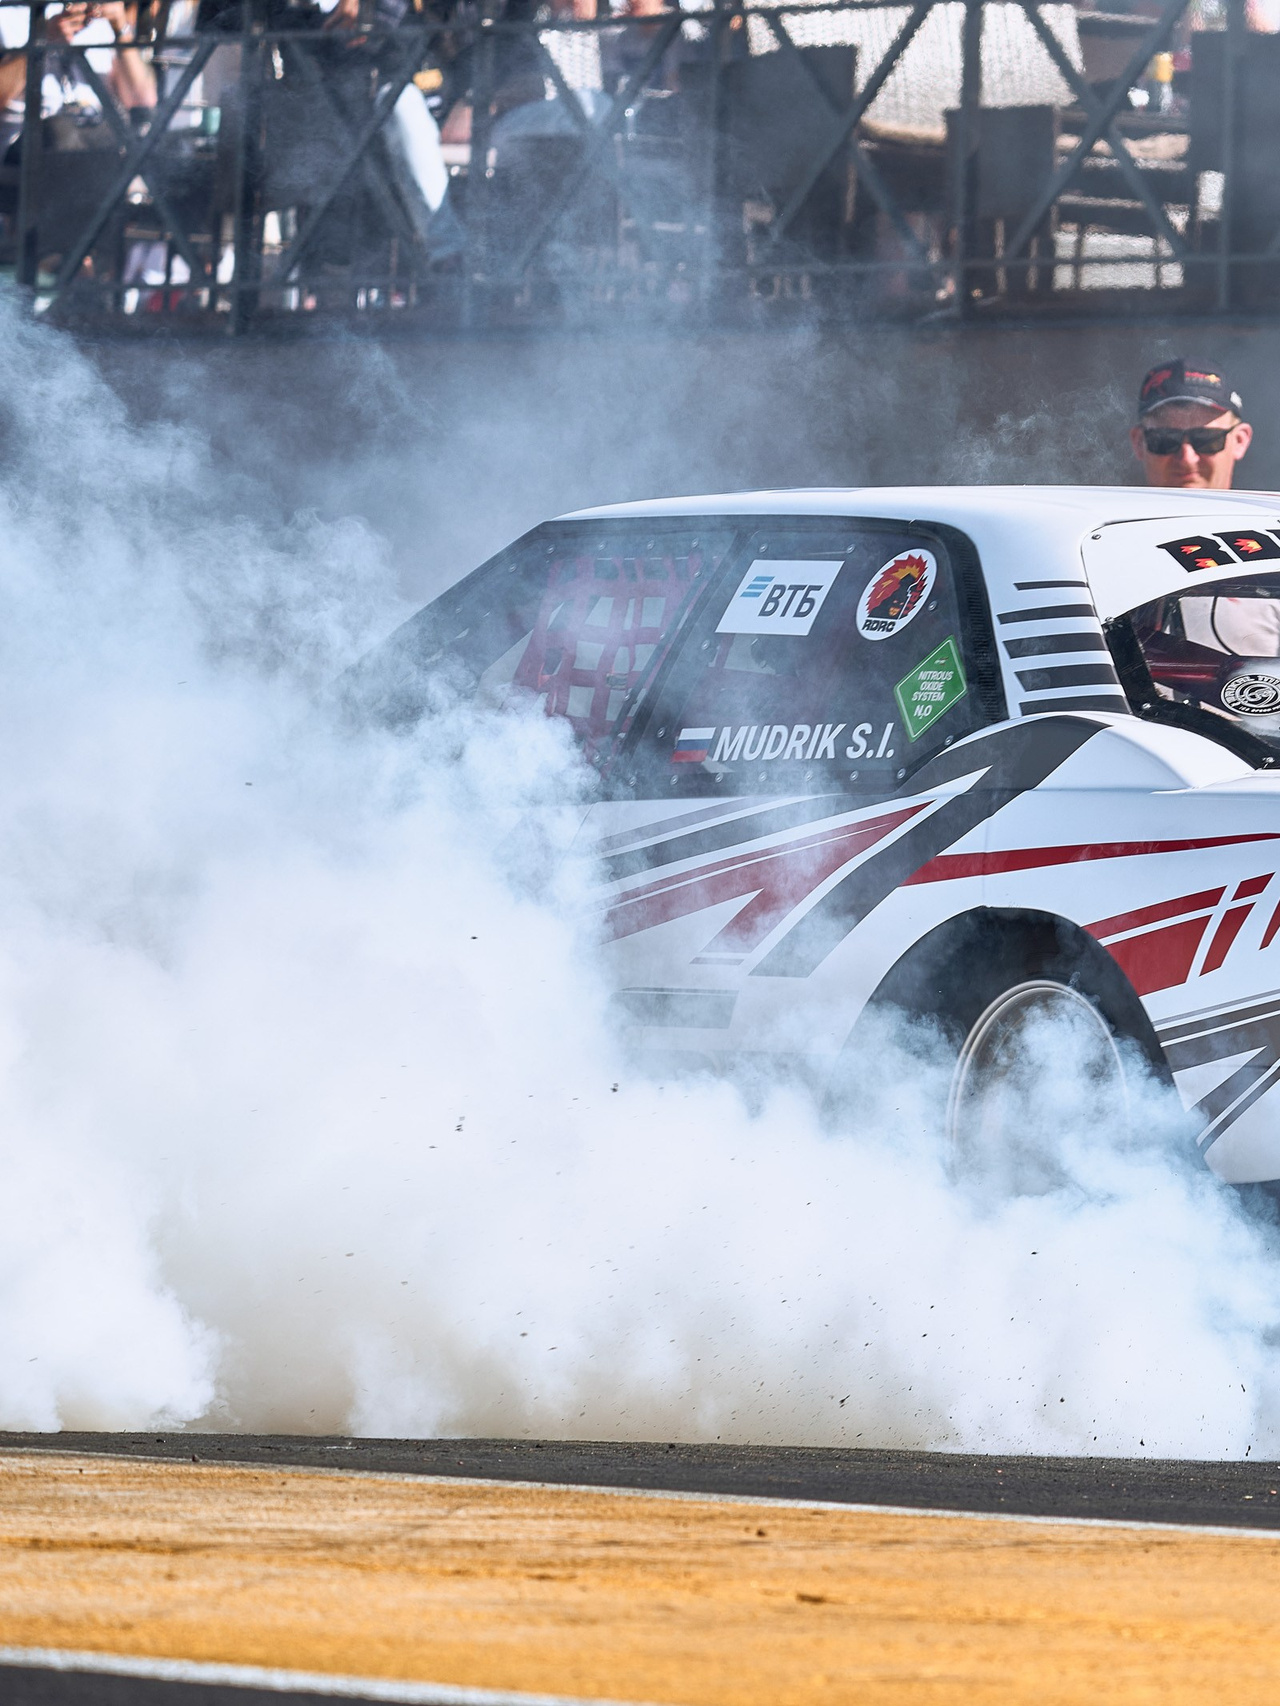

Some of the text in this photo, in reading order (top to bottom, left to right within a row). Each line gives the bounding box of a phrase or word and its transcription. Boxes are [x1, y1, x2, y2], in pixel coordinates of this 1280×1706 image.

[758, 584, 824, 617] ВТБ
[862, 620, 896, 632] RDRC
[918, 671, 953, 681] NITROUS
[920, 682, 945, 691] OXIDE
[912, 692, 945, 701] SYSTEM
[712, 722, 894, 761] MUDRIK S.I.
